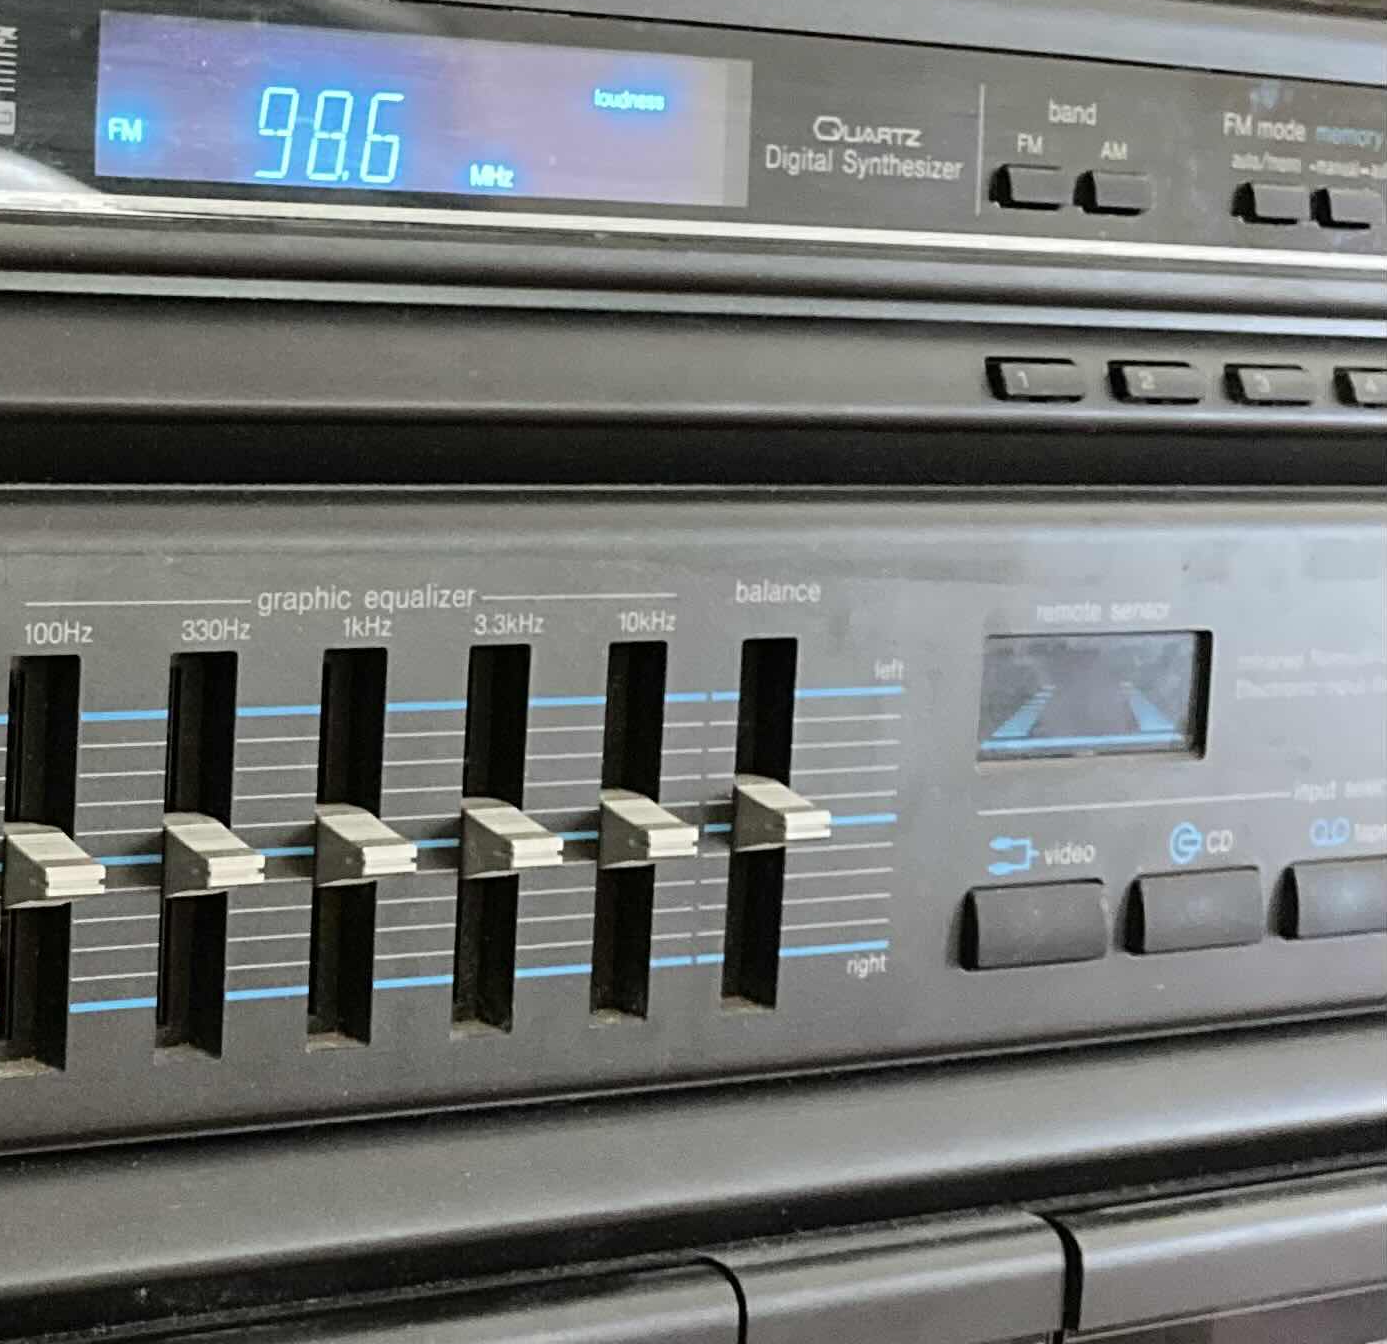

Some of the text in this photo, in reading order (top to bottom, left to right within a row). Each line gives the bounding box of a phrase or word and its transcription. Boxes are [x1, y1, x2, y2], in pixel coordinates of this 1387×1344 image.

[594, 88, 665, 112] loudness
[1048, 99, 1098, 126] band
[108, 117, 143, 143] FM
[254, 86, 405, 184] 98.6
[1222, 111, 1307, 143] FM mode
[1316, 126, 1382, 152] memory
[1017, 133, 1044, 155] FM
[1100, 140, 1128, 161] AM
[765, 143, 964, 180] Digital Synthesizer
[469, 163, 514, 189] MHz
[1017, 370, 1029, 389] 1
[1138, 370, 1156, 390] 2
[258, 583, 476, 617] graphic equalizer
[735, 580, 821, 604] balance
[475, 612, 545, 635] 3.3kHz
[619, 610, 677, 633] 10kHz
[1037, 600, 1171, 623] remote sensor
[24, 622, 93, 645] 100Hz
[181, 619, 251, 642] 330Hz
[343, 614, 393, 638] 1kHz
[875, 658, 904, 681] left
[1044, 842, 1094, 865] video
[1206, 829, 1234, 855] CD
[847, 952, 887, 979] right
